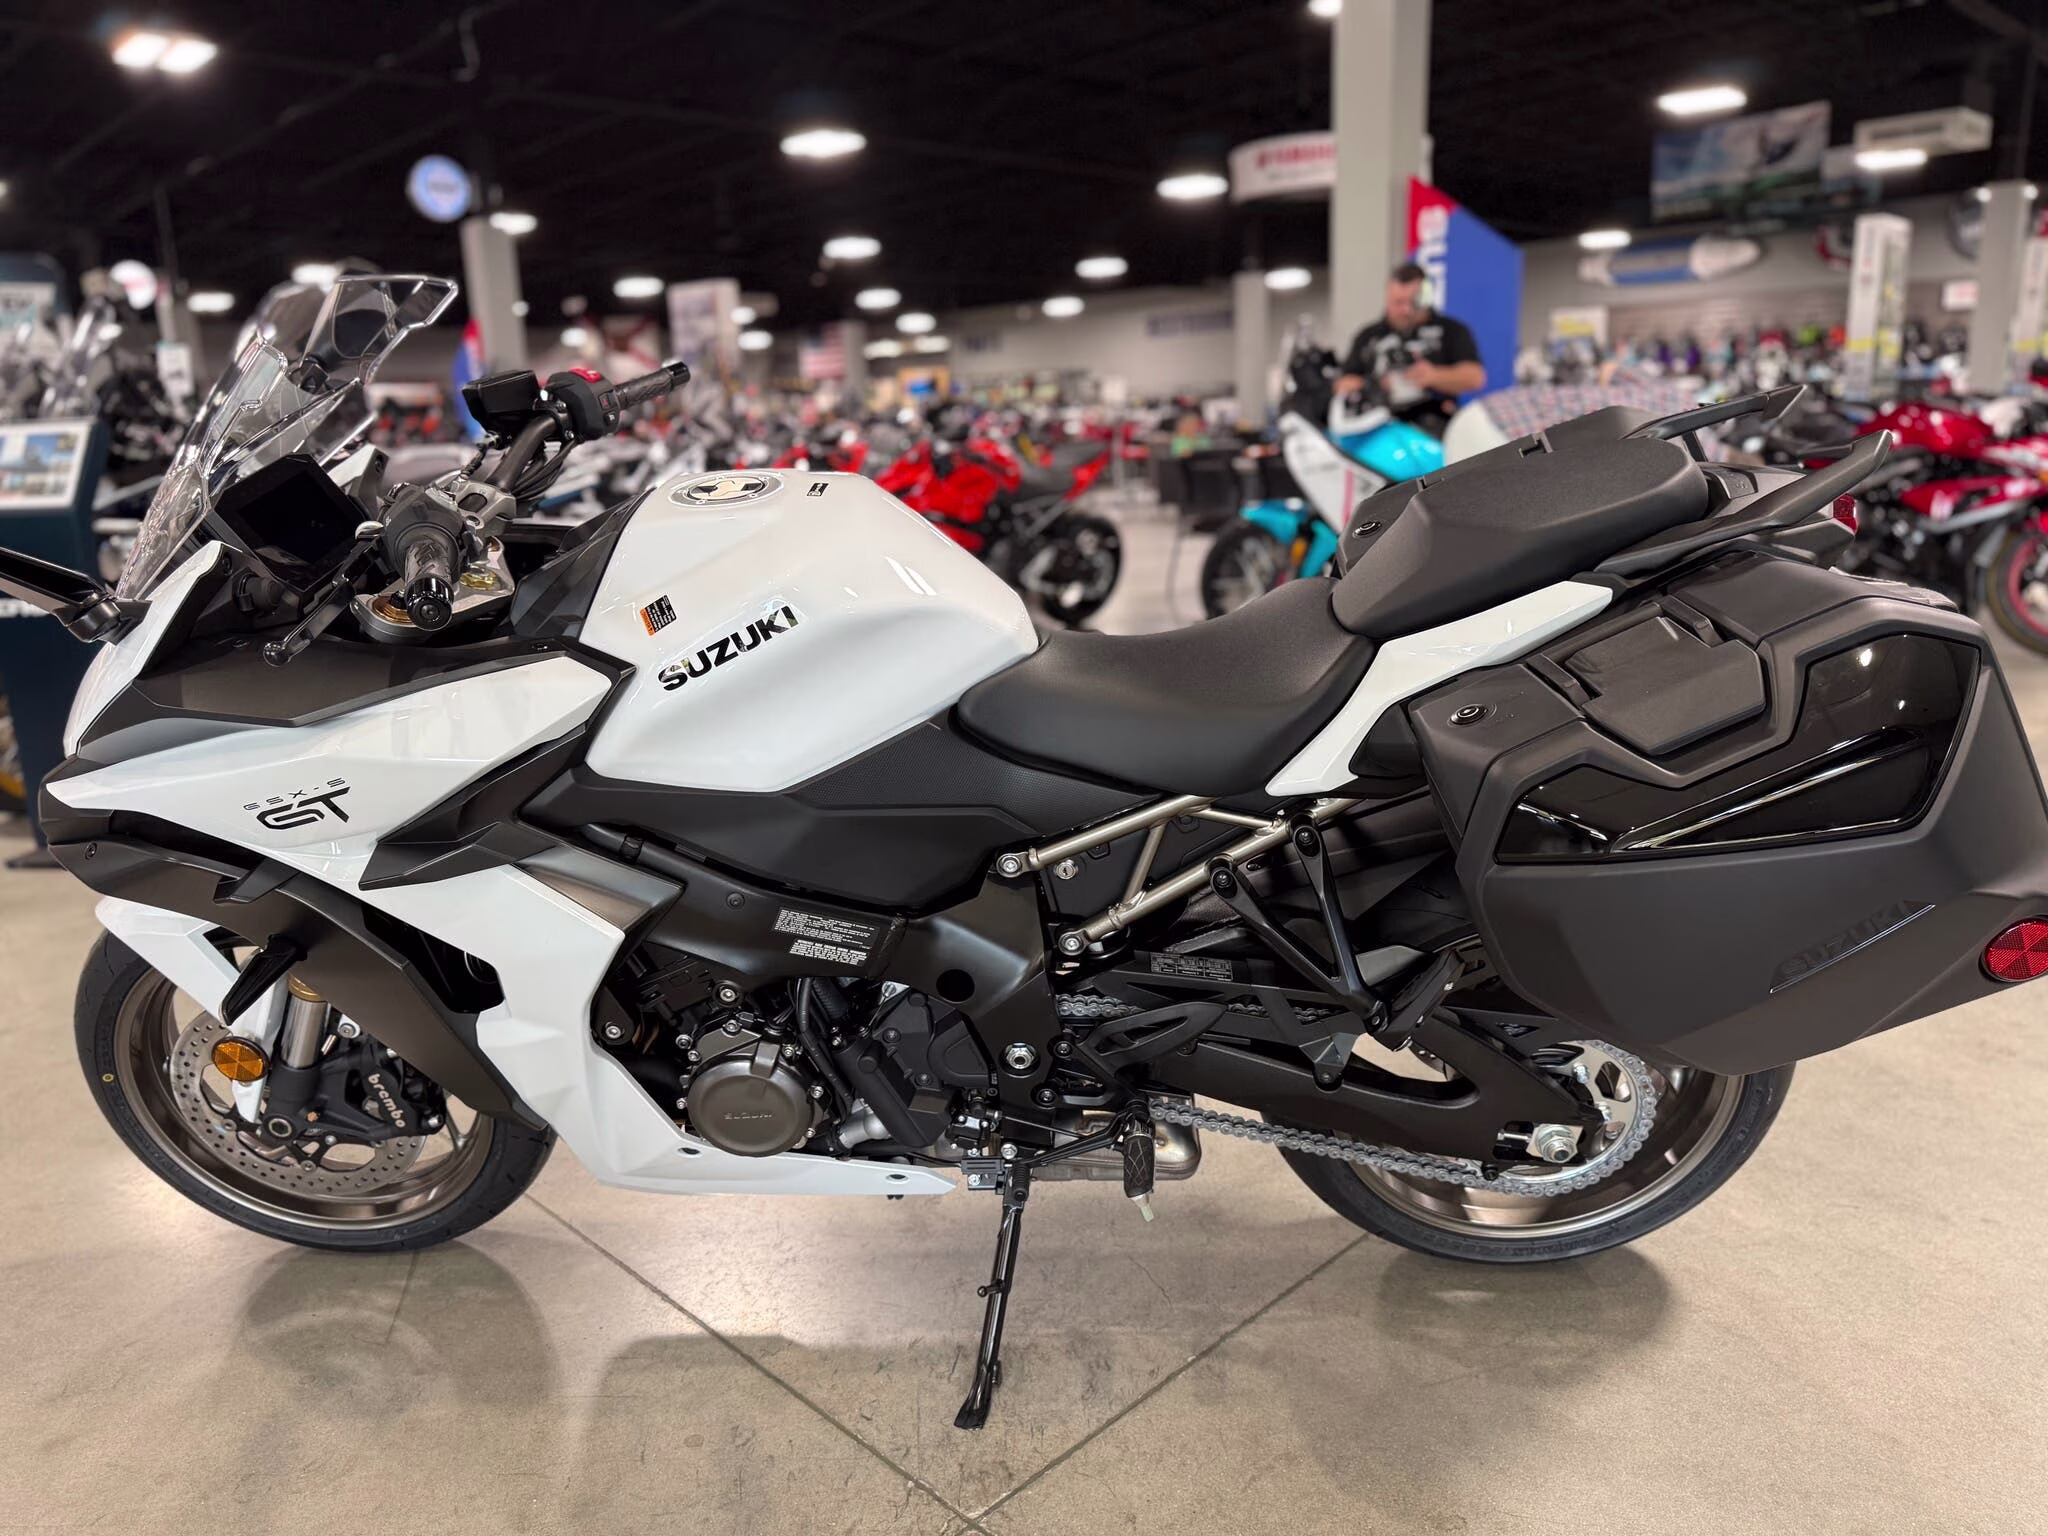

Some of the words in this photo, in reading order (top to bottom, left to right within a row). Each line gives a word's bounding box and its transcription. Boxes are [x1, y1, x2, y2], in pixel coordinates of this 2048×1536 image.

[658, 605, 799, 691] SUZUKI
[256, 786, 351, 830] GT
[1779, 900, 1912, 977] SUZUKI
[368, 1073, 406, 1128] brembo
